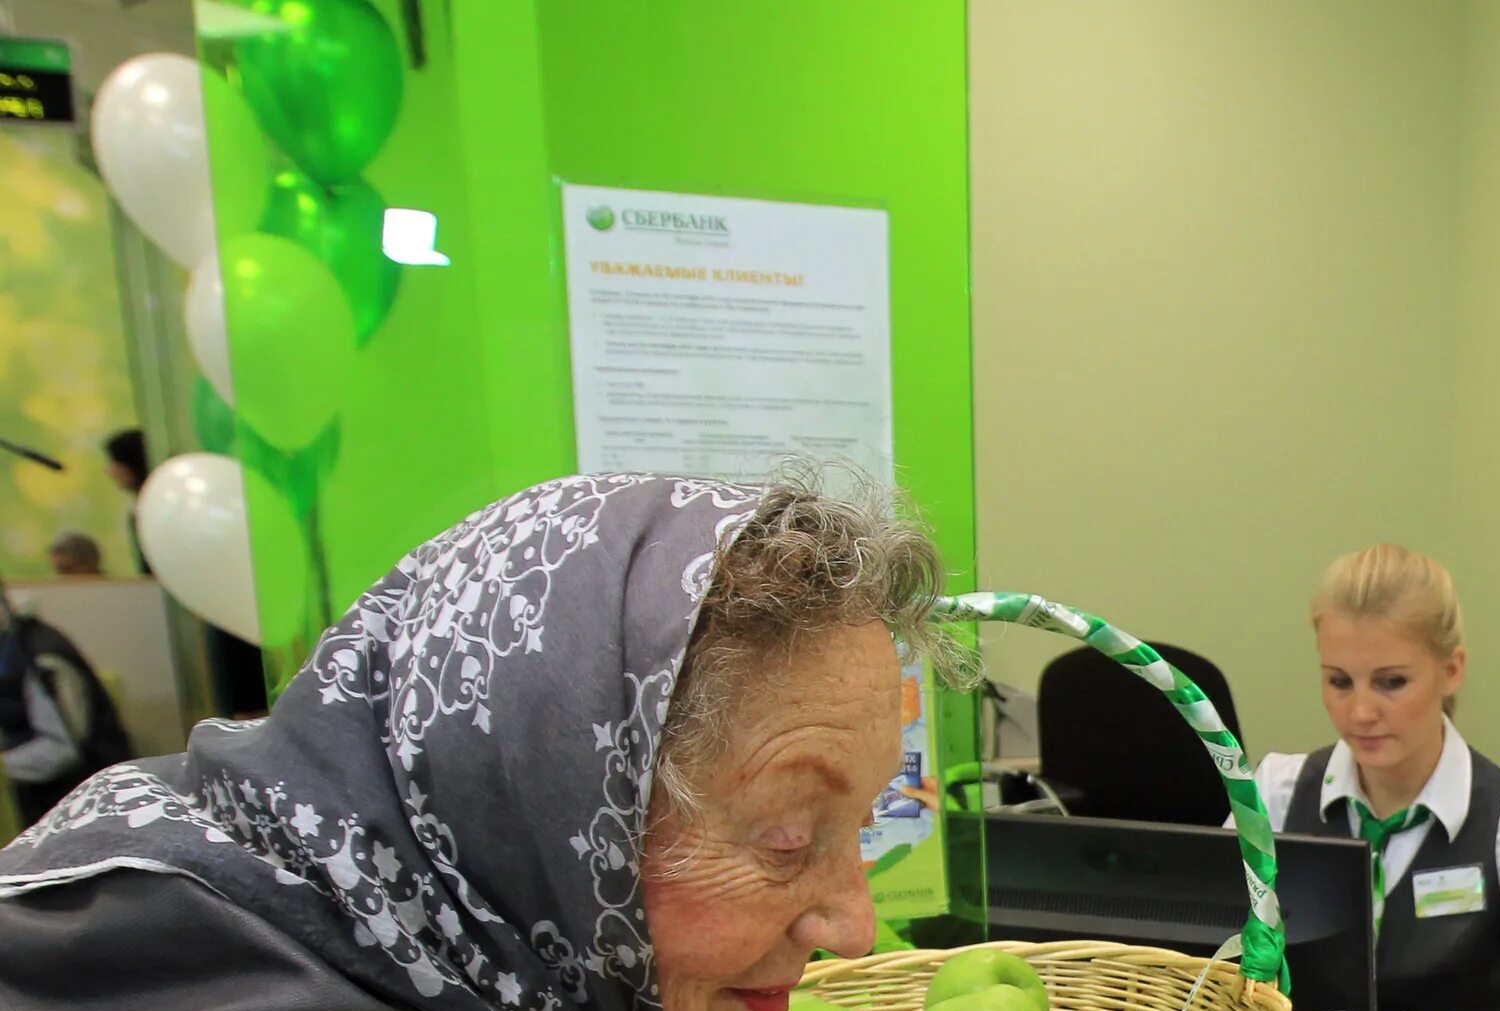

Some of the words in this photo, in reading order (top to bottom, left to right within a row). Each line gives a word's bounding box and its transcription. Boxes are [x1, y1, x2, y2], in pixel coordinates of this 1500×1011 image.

[621, 208, 729, 232] СБЕРБАНК
[589, 260, 708, 281] УВАЖАЕМЫЕ
[712, 269, 805, 286] КЛИЕНТЫ!
